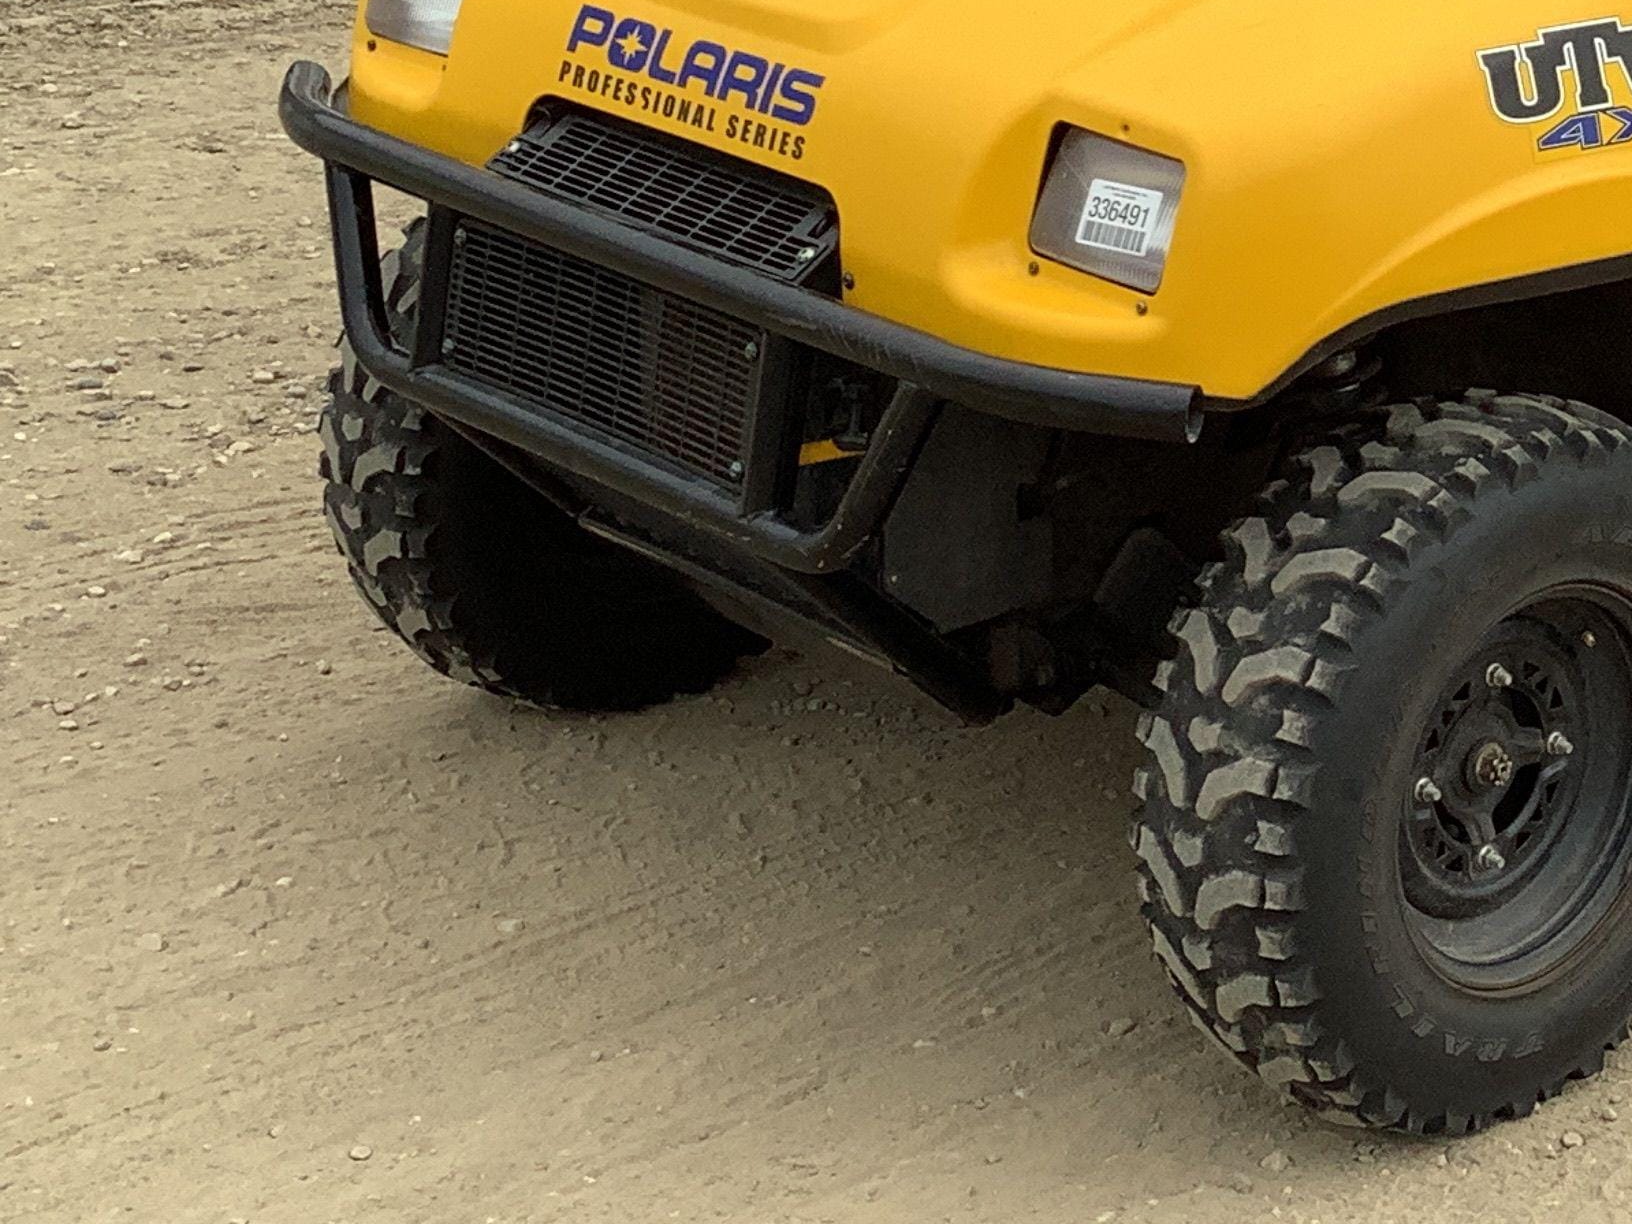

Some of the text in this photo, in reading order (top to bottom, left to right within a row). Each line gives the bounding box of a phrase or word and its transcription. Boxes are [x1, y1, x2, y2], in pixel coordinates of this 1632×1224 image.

[557, 59, 807, 161] PROFESSIONAL SERIES
[566, 3, 827, 127] POLARIS
[1087, 195, 1151, 230] 336491
